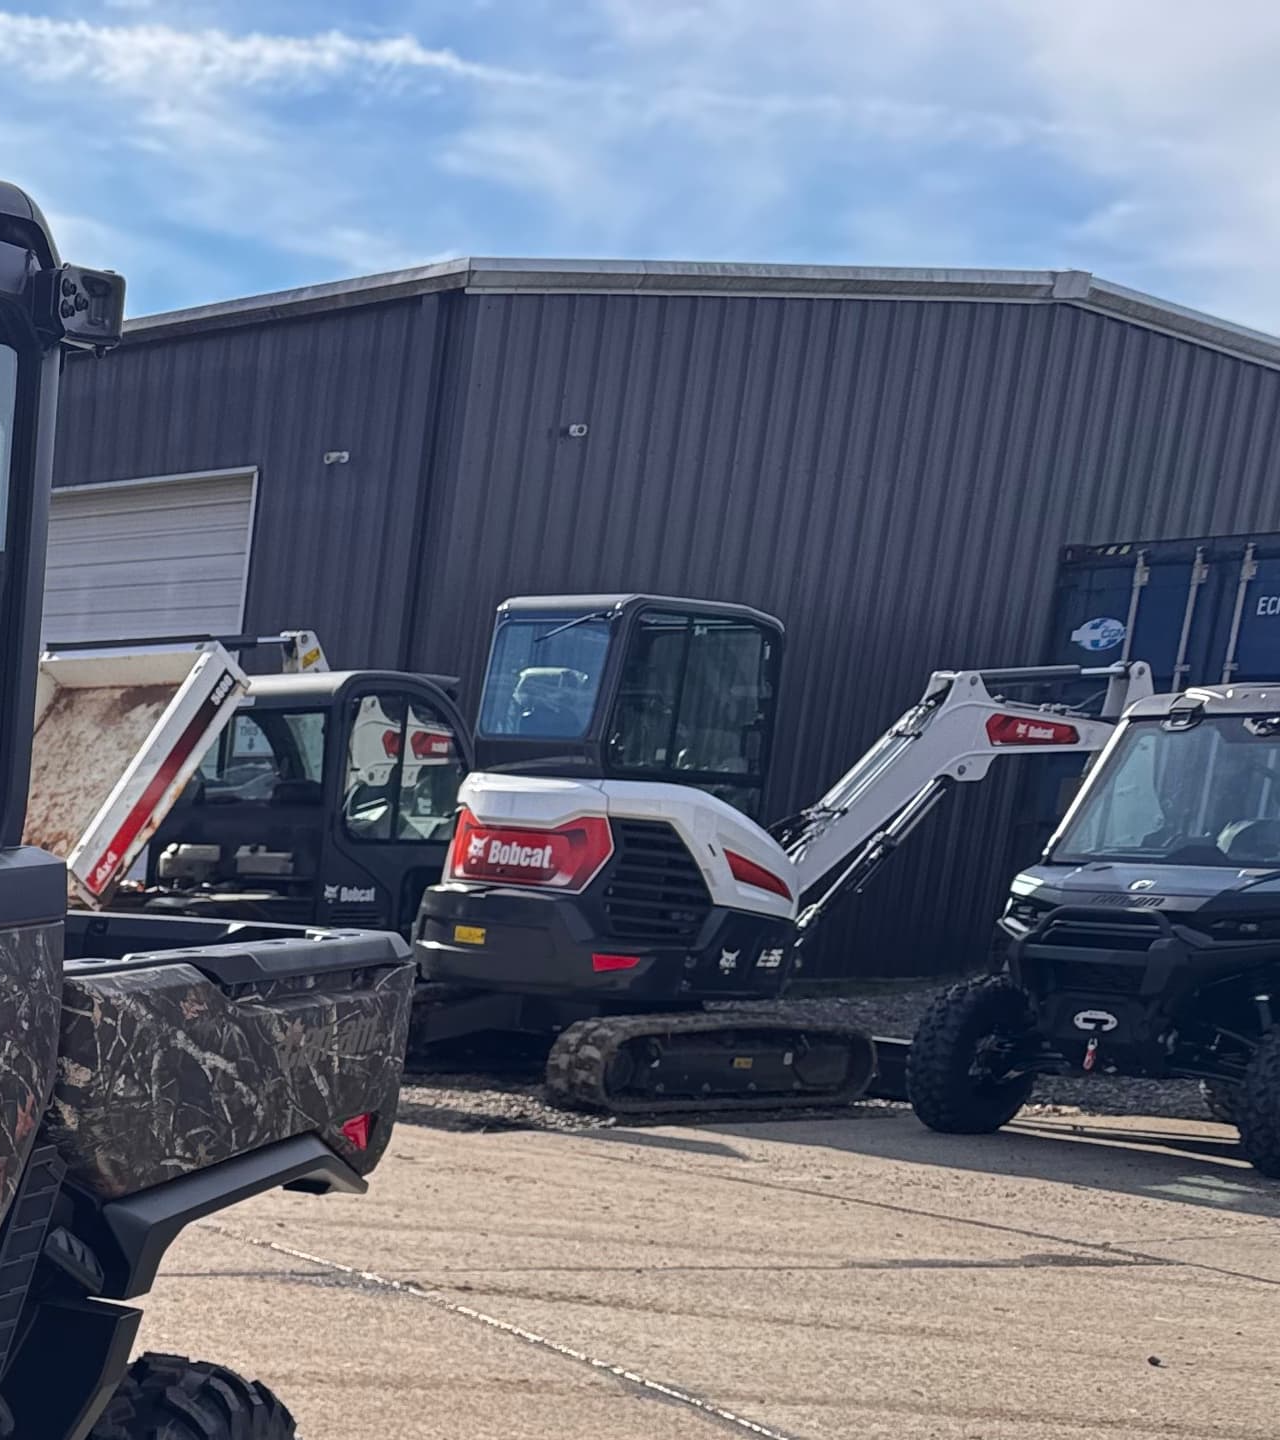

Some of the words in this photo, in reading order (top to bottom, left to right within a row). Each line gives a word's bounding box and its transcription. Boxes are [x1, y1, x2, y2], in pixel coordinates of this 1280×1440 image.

[1256, 597, 1280, 616] EC
[487, 840, 552, 869] Bobcat
[95, 850, 118, 885] 4x4
[340, 886, 376, 902] Bobcat
